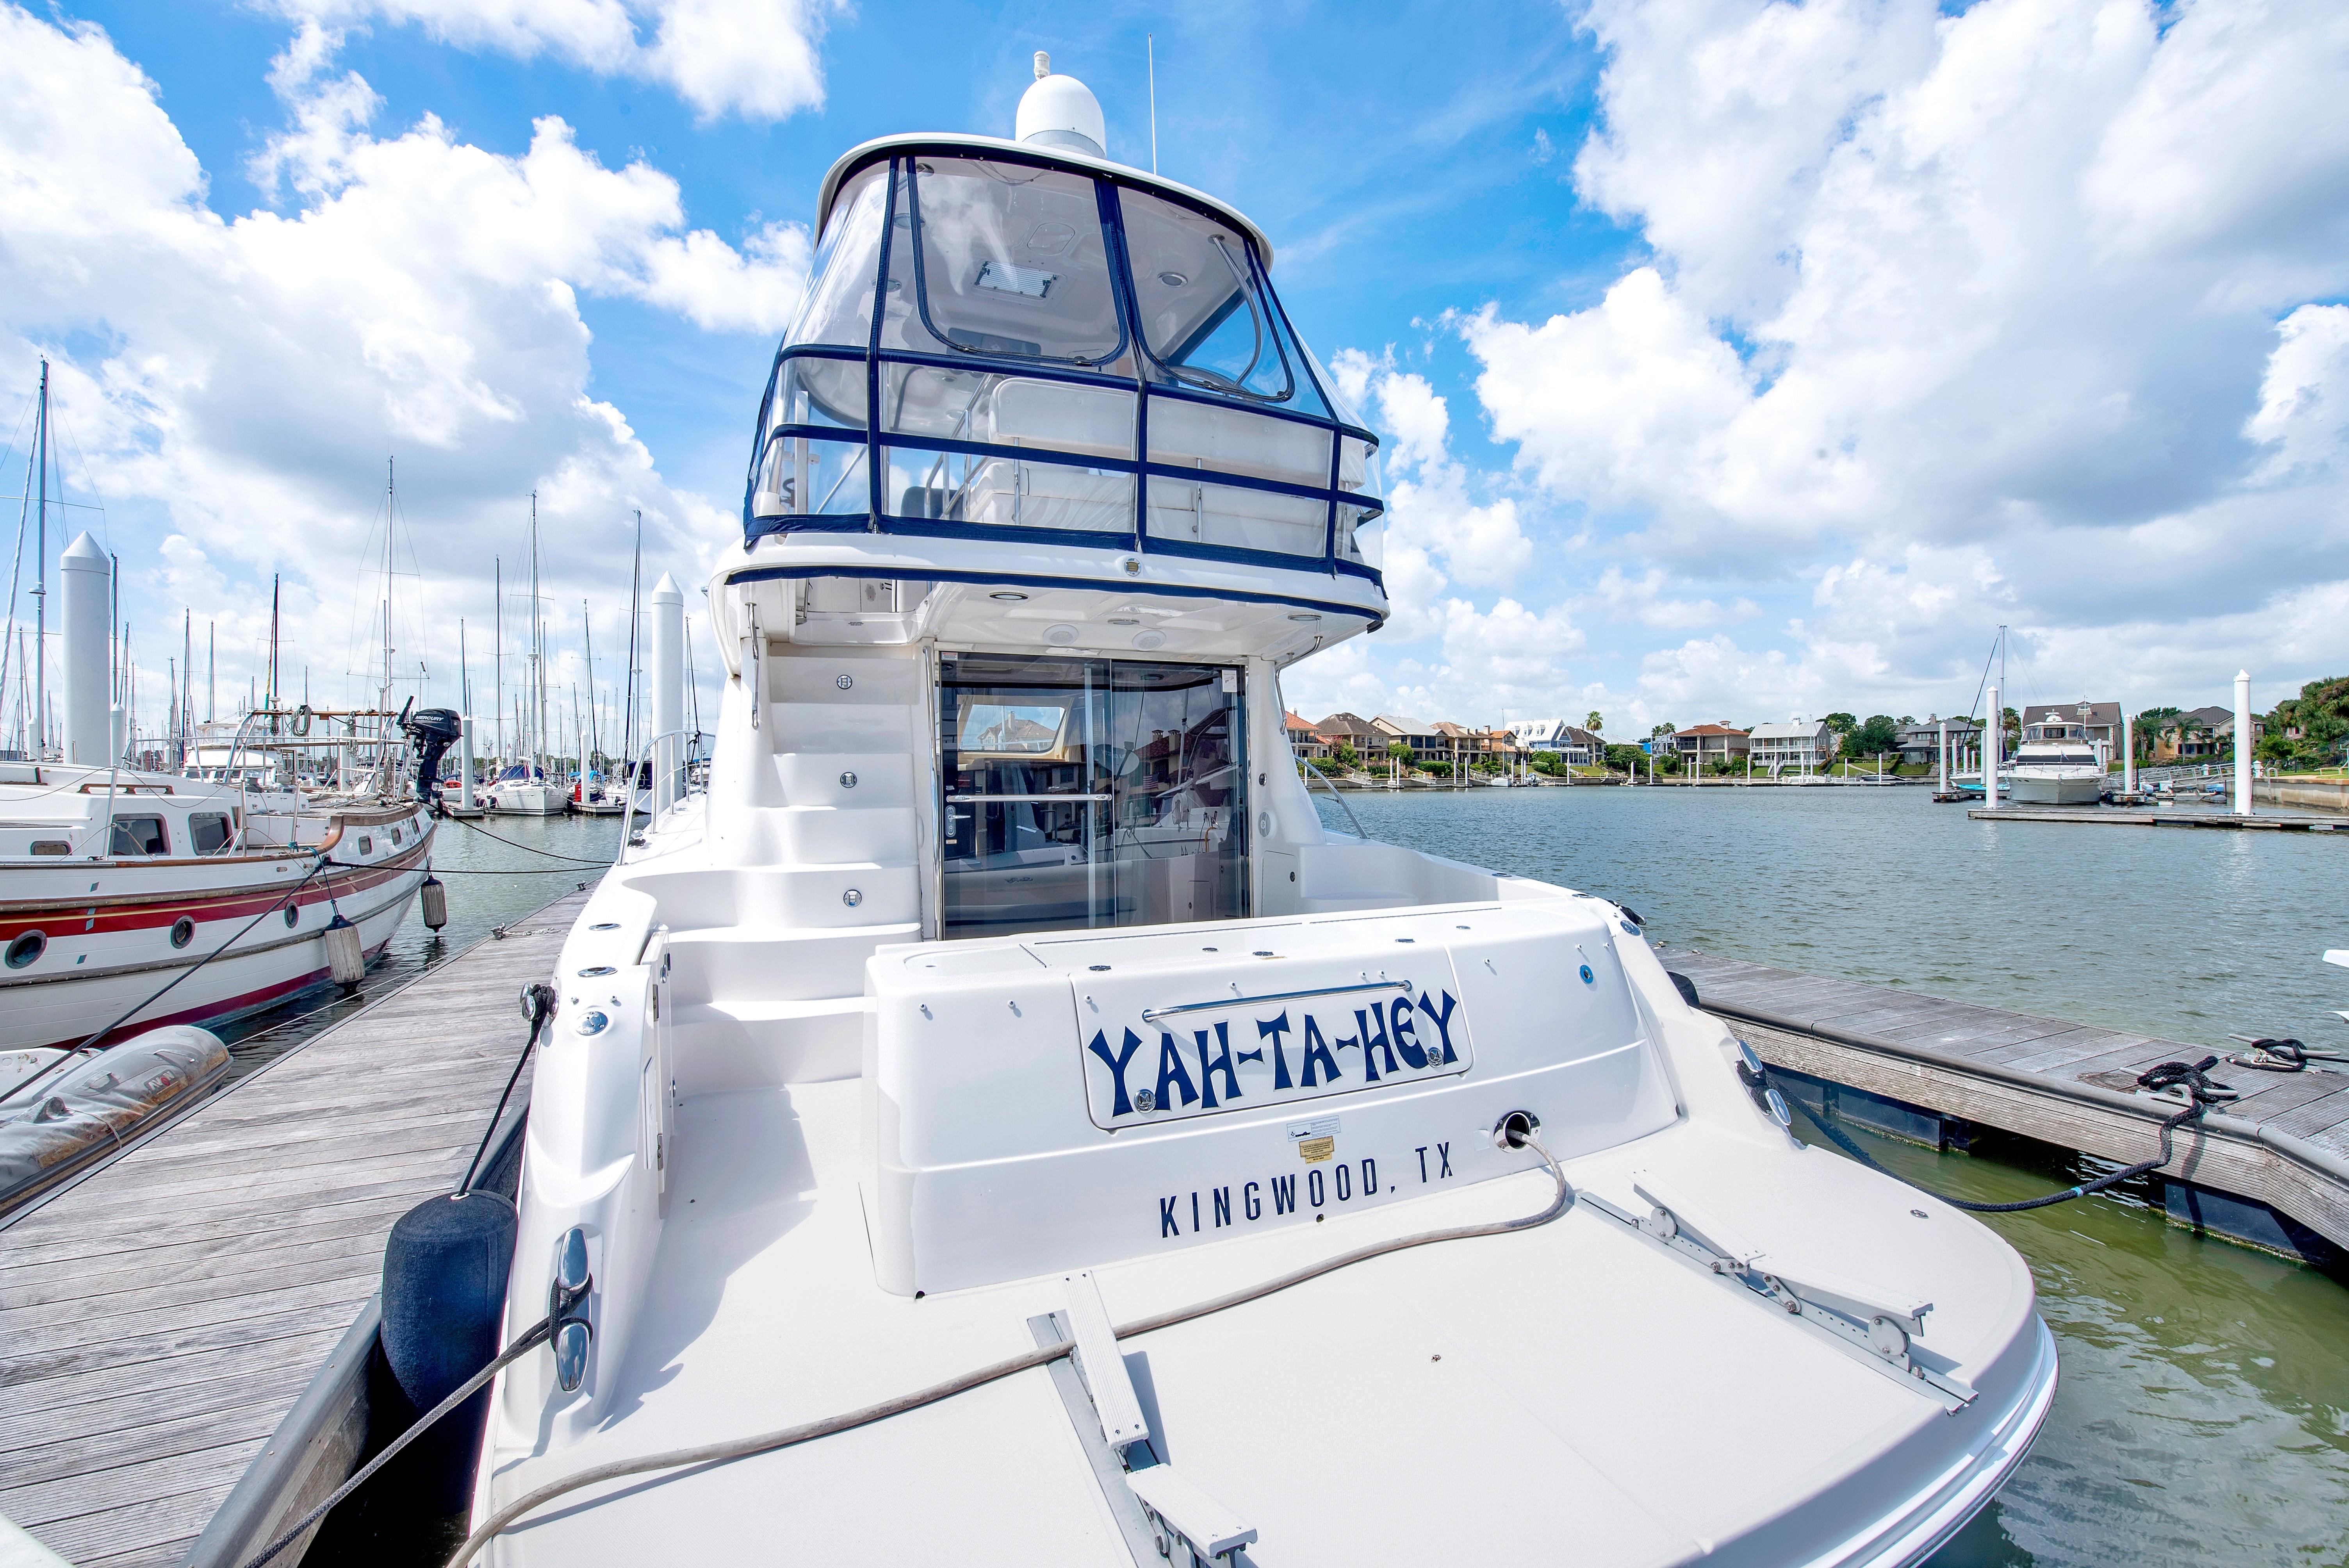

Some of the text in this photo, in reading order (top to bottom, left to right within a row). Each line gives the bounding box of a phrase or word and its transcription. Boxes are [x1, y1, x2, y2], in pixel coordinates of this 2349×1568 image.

[148, 1071, 175, 1091] AVON
[1088, 989, 1458, 1117] YAH-TA-HEY
[1160, 1142, 1453, 1238] KINGWOOD, TX
